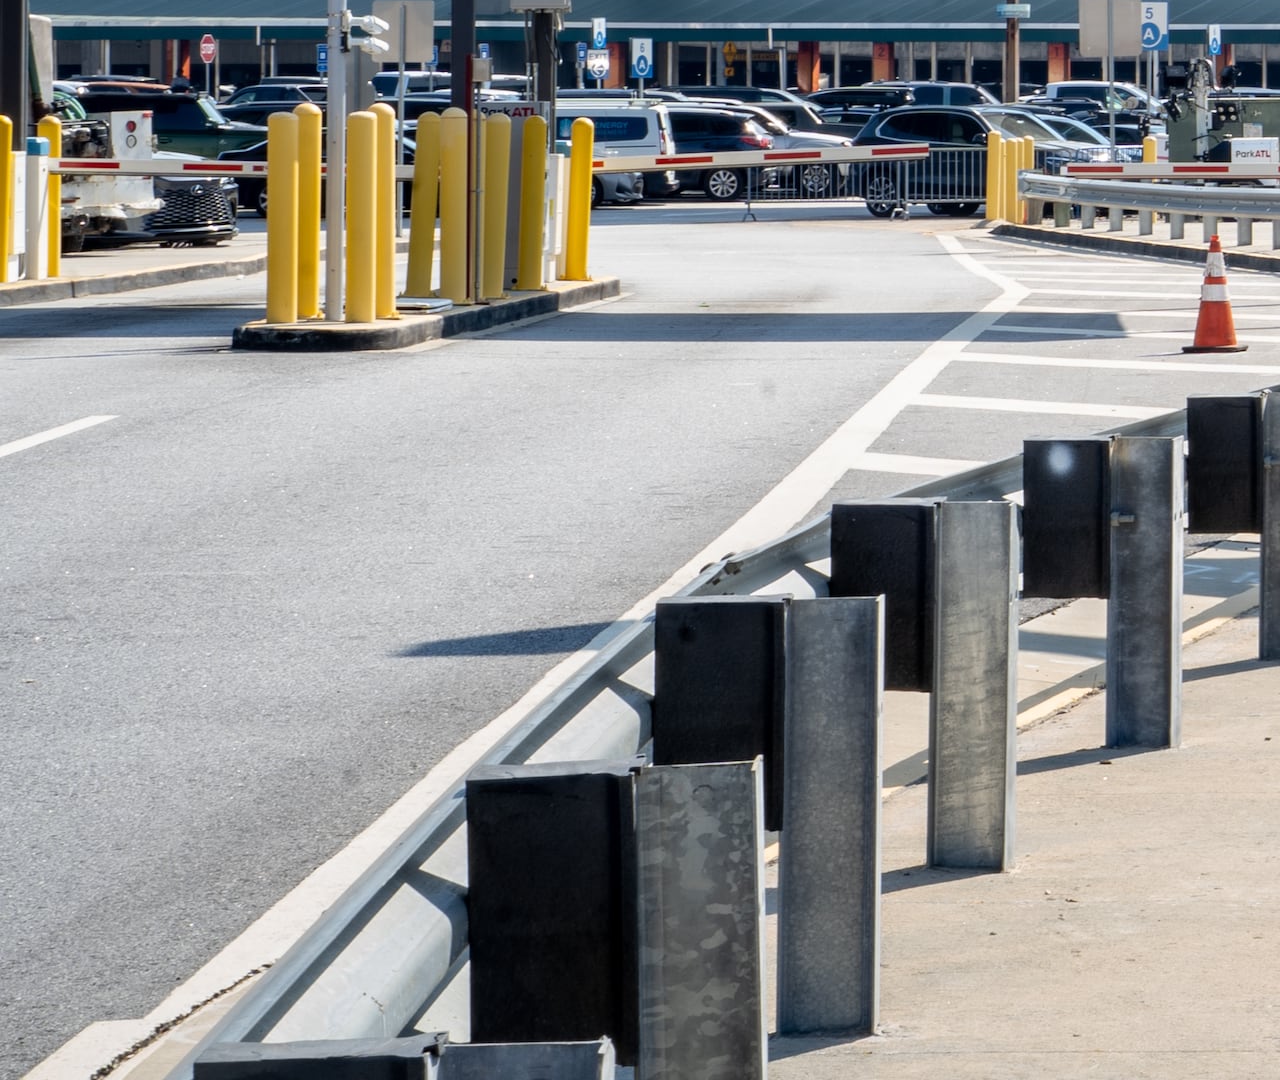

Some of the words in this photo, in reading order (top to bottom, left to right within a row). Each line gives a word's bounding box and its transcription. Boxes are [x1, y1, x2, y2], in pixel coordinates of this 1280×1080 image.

[1145, 7, 1154, 19] 5
[1142, 27, 1155, 40] A
[638, 59, 646, 69] A
[1235, 149, 1271, 158] ParkATL
